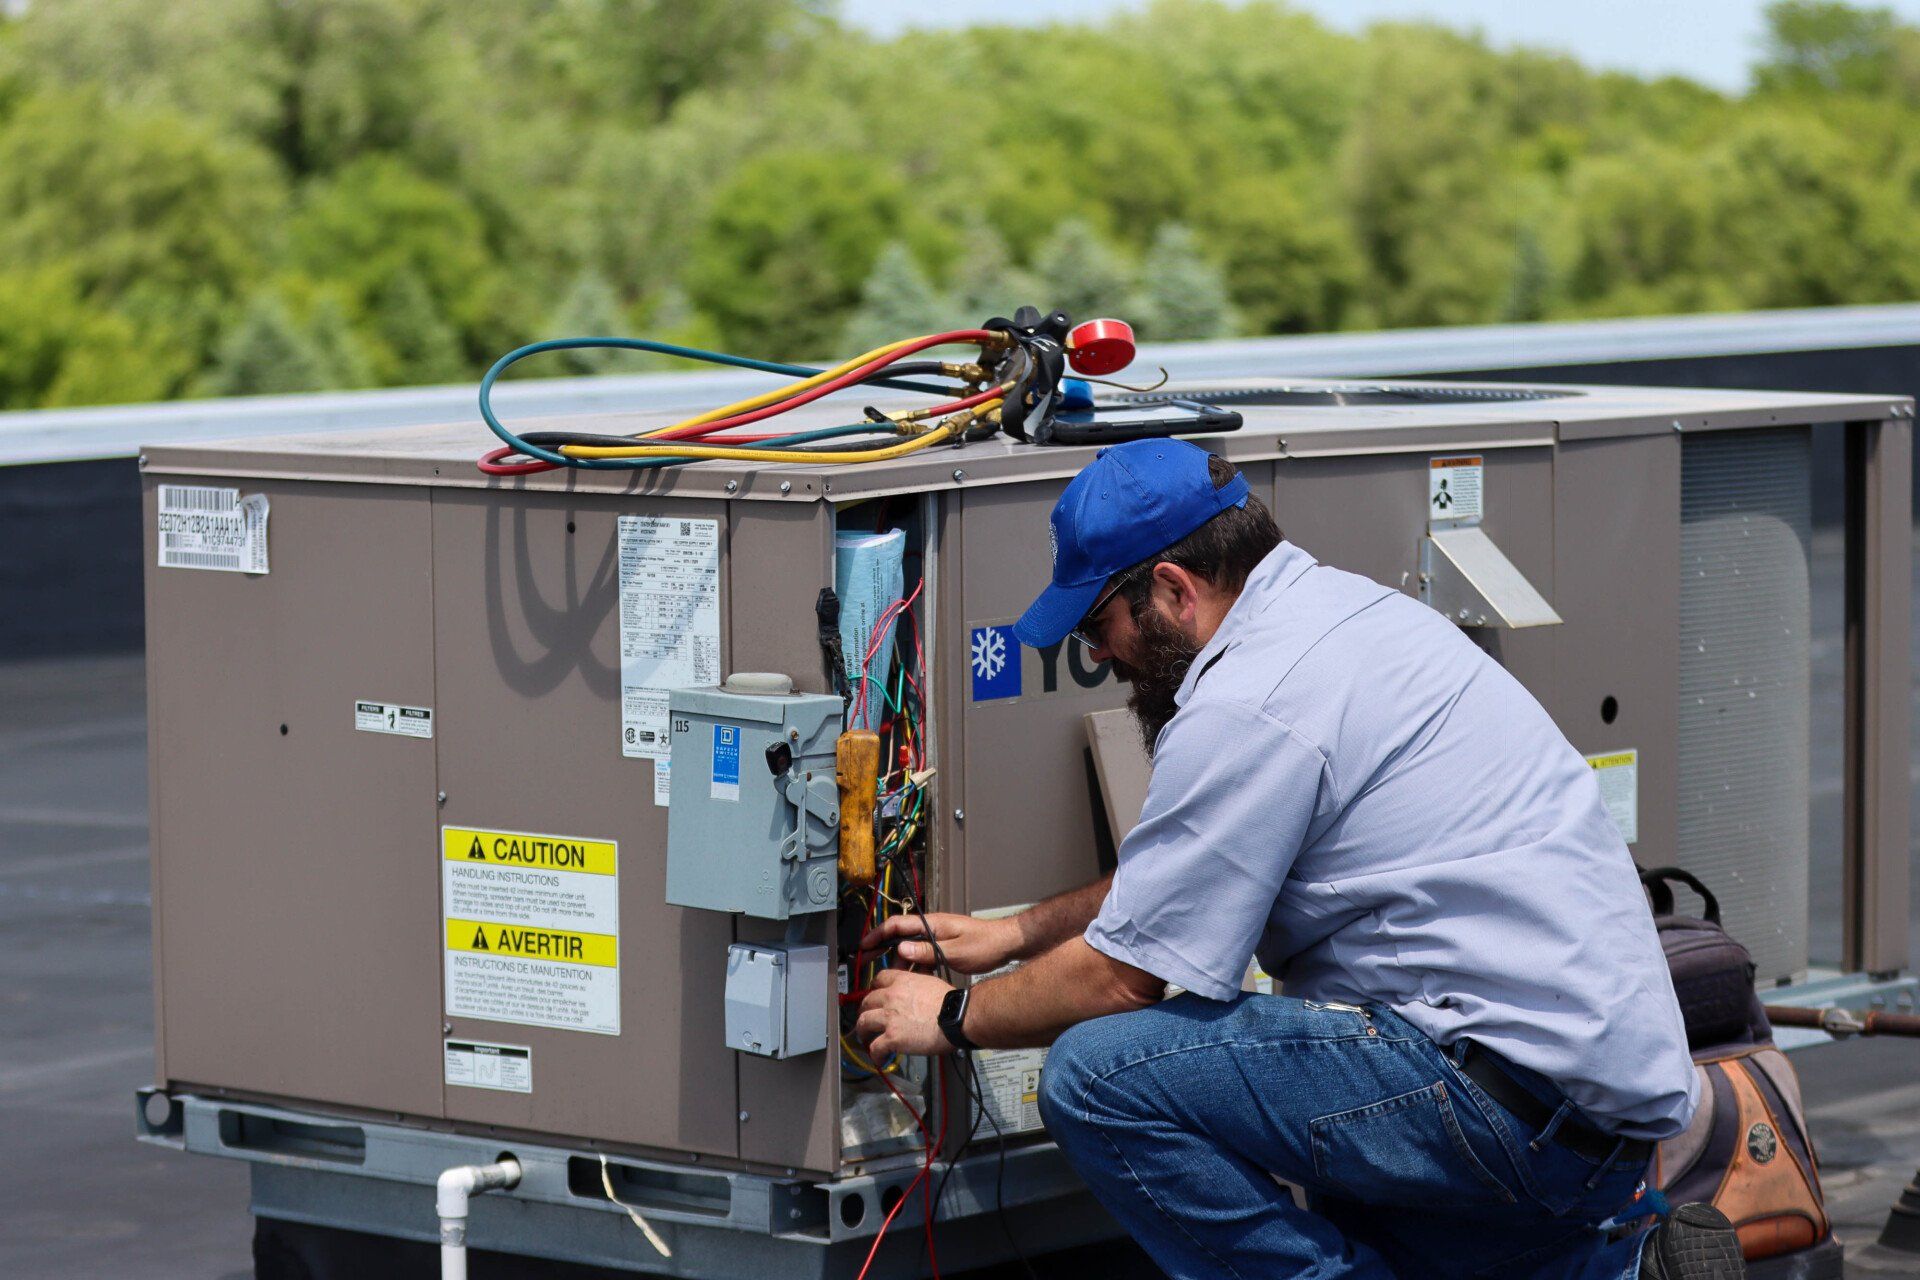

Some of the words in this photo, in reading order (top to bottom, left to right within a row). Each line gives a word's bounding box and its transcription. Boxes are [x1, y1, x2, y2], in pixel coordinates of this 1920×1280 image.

[675, 720, 690, 733] 115
[494, 838, 584, 868] CAUTION
[452, 866, 495, 881] HANDLING
[496, 870, 560, 887] INSTRUCTIONS
[534, 890, 559, 898] minimum
[566, 900, 587, 910] prevent
[498, 930, 583, 959] AVERTIR
[455, 956, 516, 973] INSTRUCTIONS
[517, 963, 529, 974] DE
[530, 964, 592, 981] MANUTENTION
